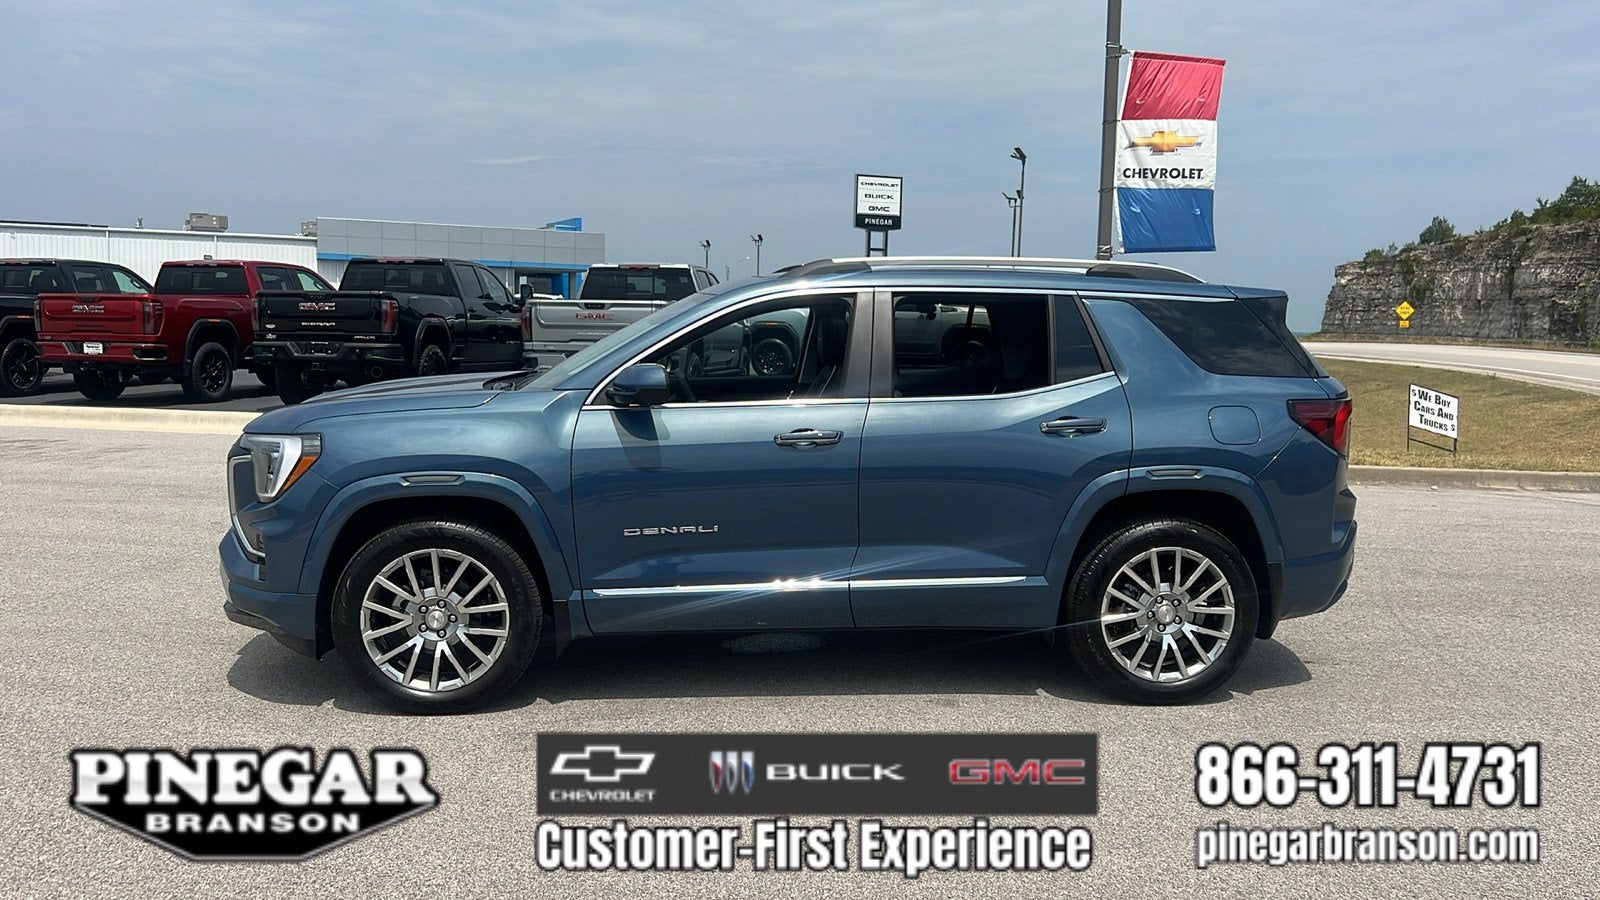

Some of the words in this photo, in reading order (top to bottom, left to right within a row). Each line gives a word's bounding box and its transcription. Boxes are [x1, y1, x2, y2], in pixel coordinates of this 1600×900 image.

[1122, 167, 1204, 180] CHEVROLET
[864, 217, 893, 226] PINEGAR
[1437, 407, 1454, 421] AND
[1418, 413, 1449, 432] TRUCKS
[623, 525, 719, 537] DENALI
